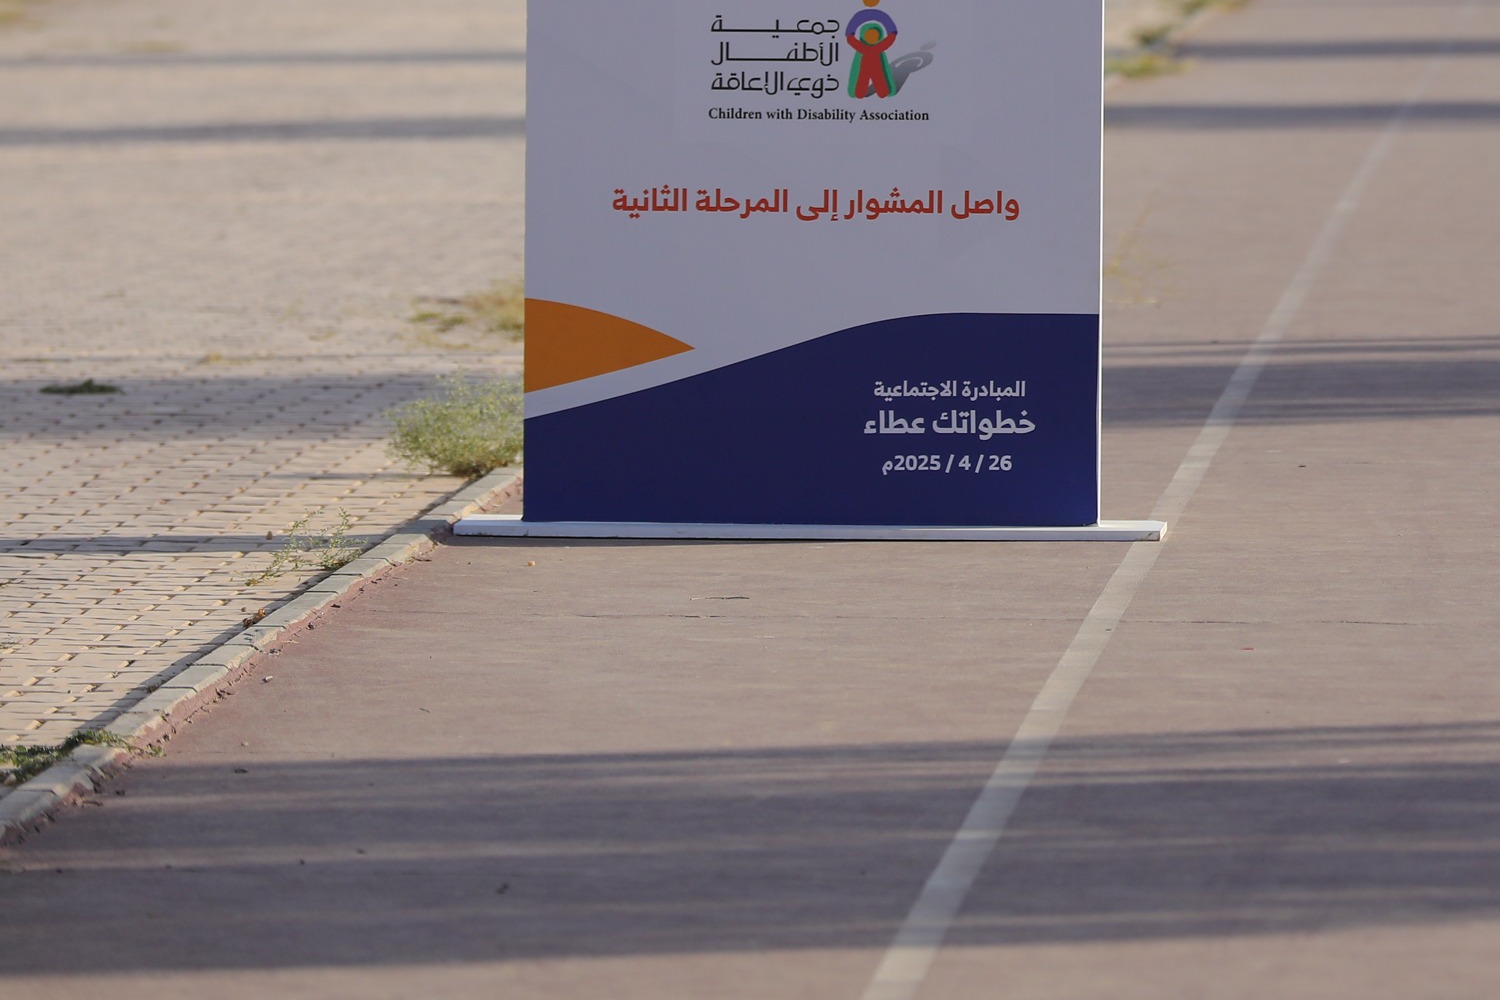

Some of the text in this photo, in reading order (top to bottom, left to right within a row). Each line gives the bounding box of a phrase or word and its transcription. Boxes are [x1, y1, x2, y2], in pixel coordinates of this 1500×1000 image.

[710, 14, 840, 39] جمعية
[708, 108, 930, 124] Children with Disability Association
[612, 184, 1020, 222] واصل المشوار إلى المرحلة الثانية
[873, 380, 1027, 402] المبادرة الاجتماعية
[863, 409, 1037, 441] خطواتك عطاء
[988, 455, 1013, 472] 26
